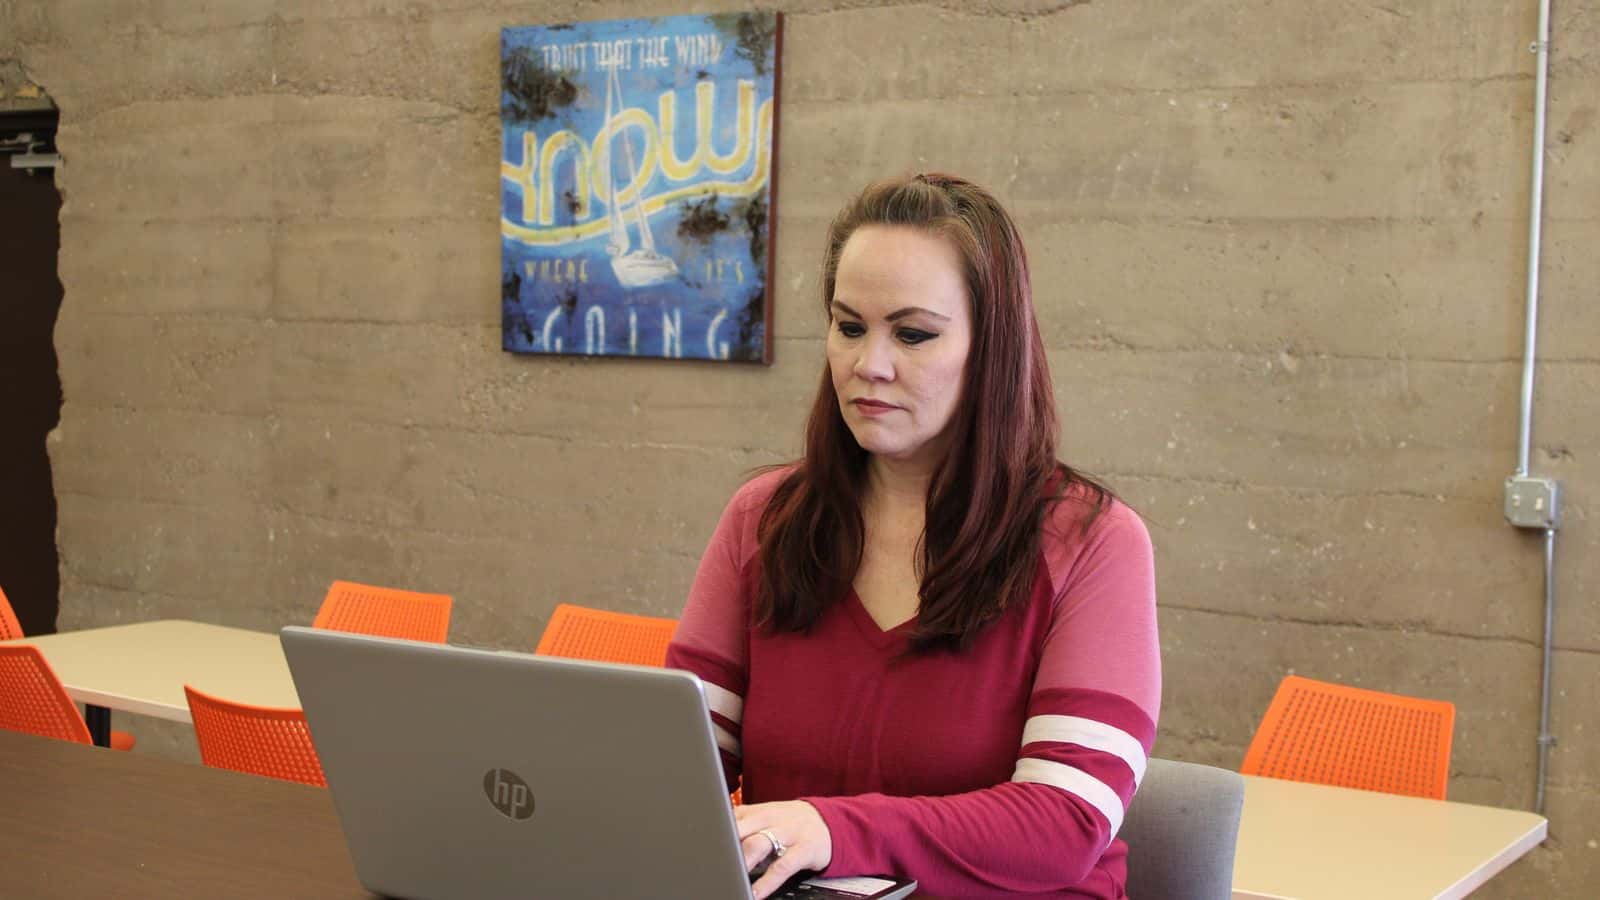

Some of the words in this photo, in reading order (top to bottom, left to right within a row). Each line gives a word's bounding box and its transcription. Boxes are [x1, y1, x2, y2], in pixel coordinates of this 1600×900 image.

[542, 44, 587, 71] TRUST
[591, 40, 632, 70] THAT
[636, 37, 670, 68] THE
[674, 34, 722, 65] WIND
[524, 259, 588, 283] WHERE
[543, 305, 730, 360] GOING
[494, 768, 528, 820] hp
